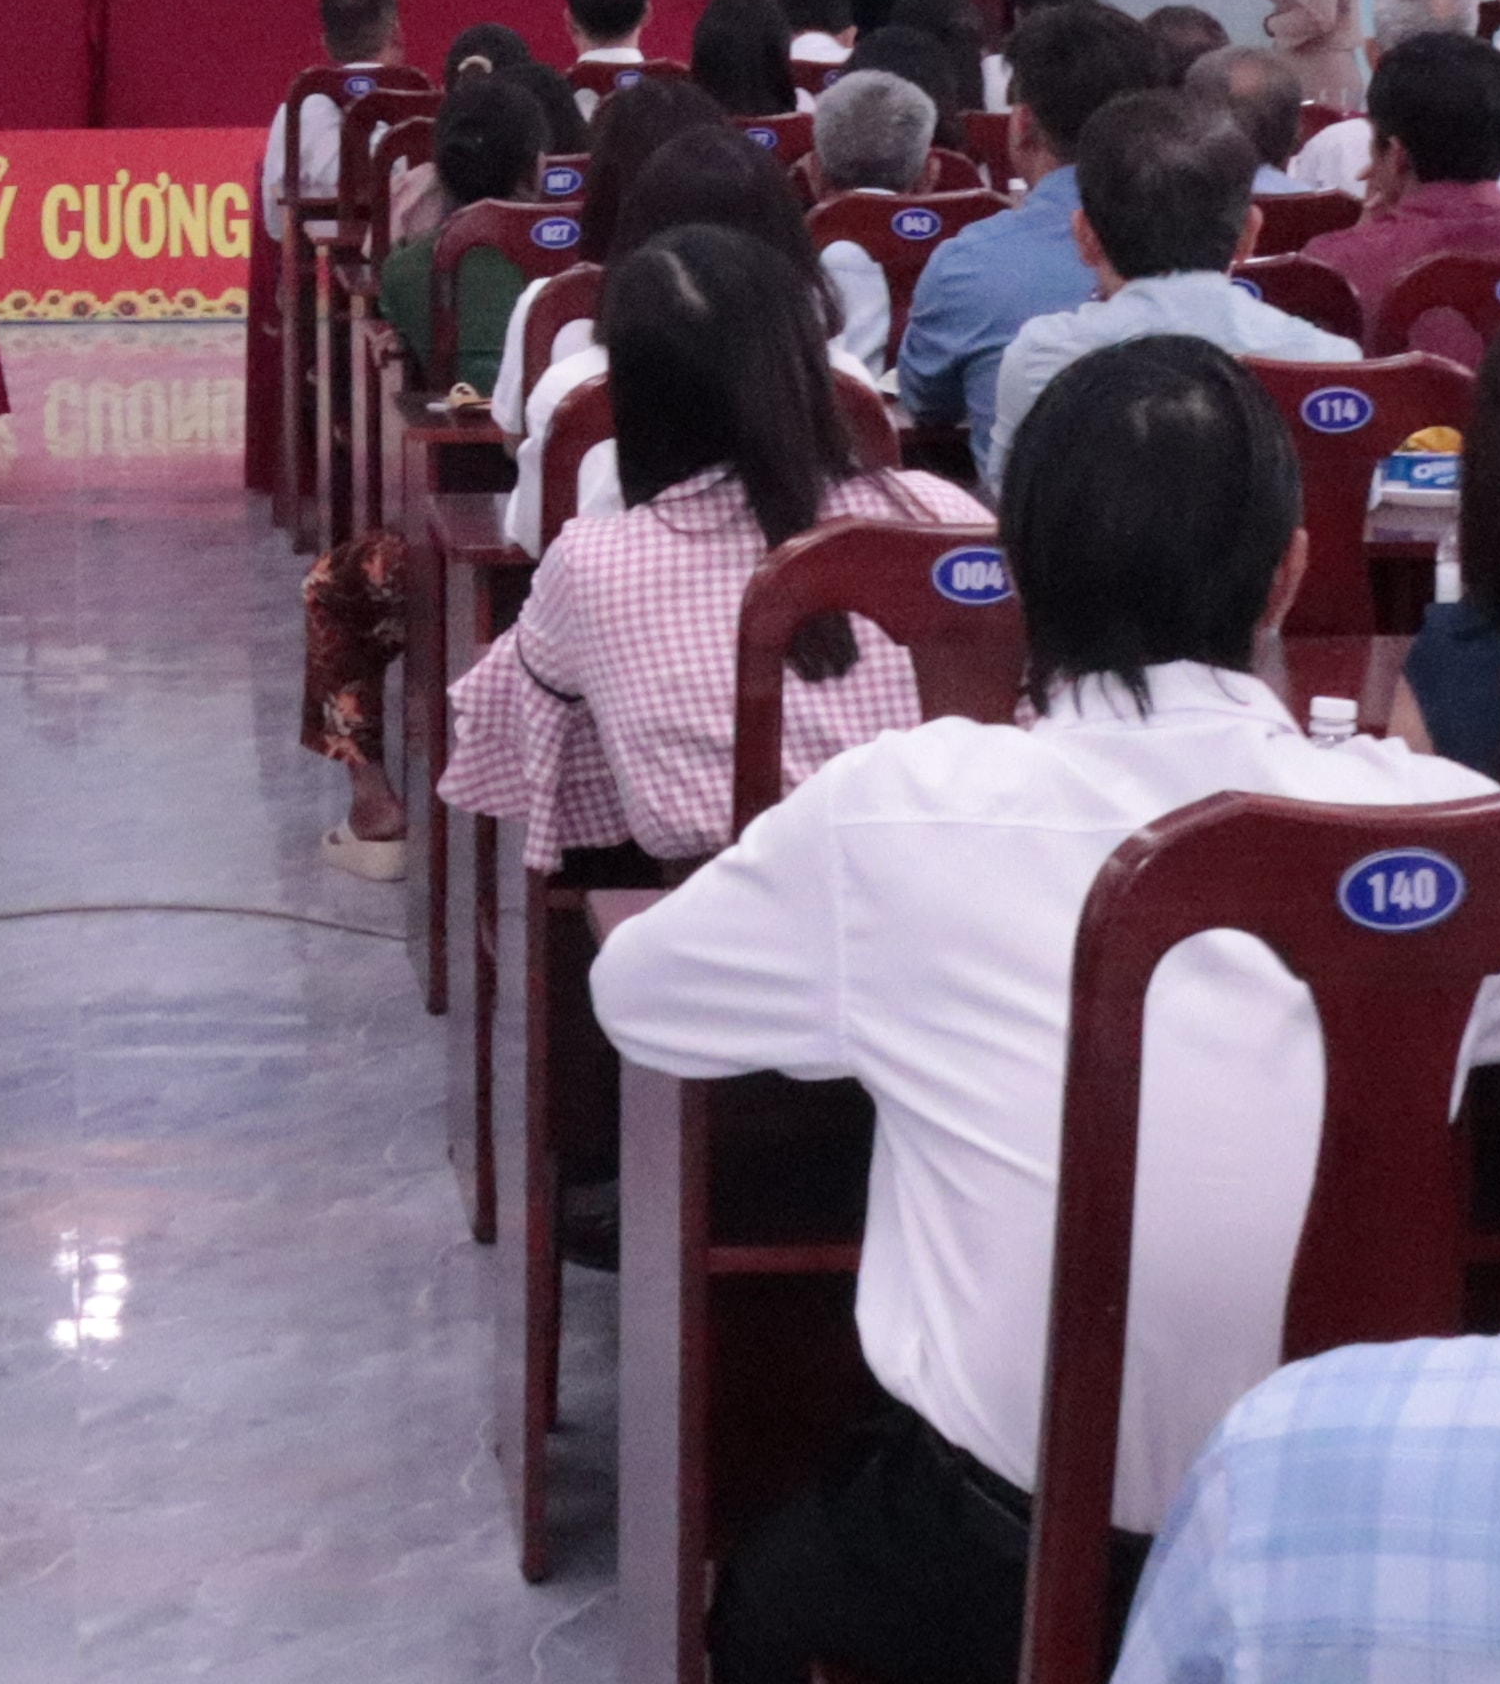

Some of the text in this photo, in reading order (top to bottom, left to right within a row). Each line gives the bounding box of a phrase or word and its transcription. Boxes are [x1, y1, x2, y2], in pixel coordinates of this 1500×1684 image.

[42, 170, 250, 259] CƯƠNG
[1317, 400, 1359, 423] 114
[951, 561, 1005, 591] 004
[1366, 869, 1437, 913] 140
